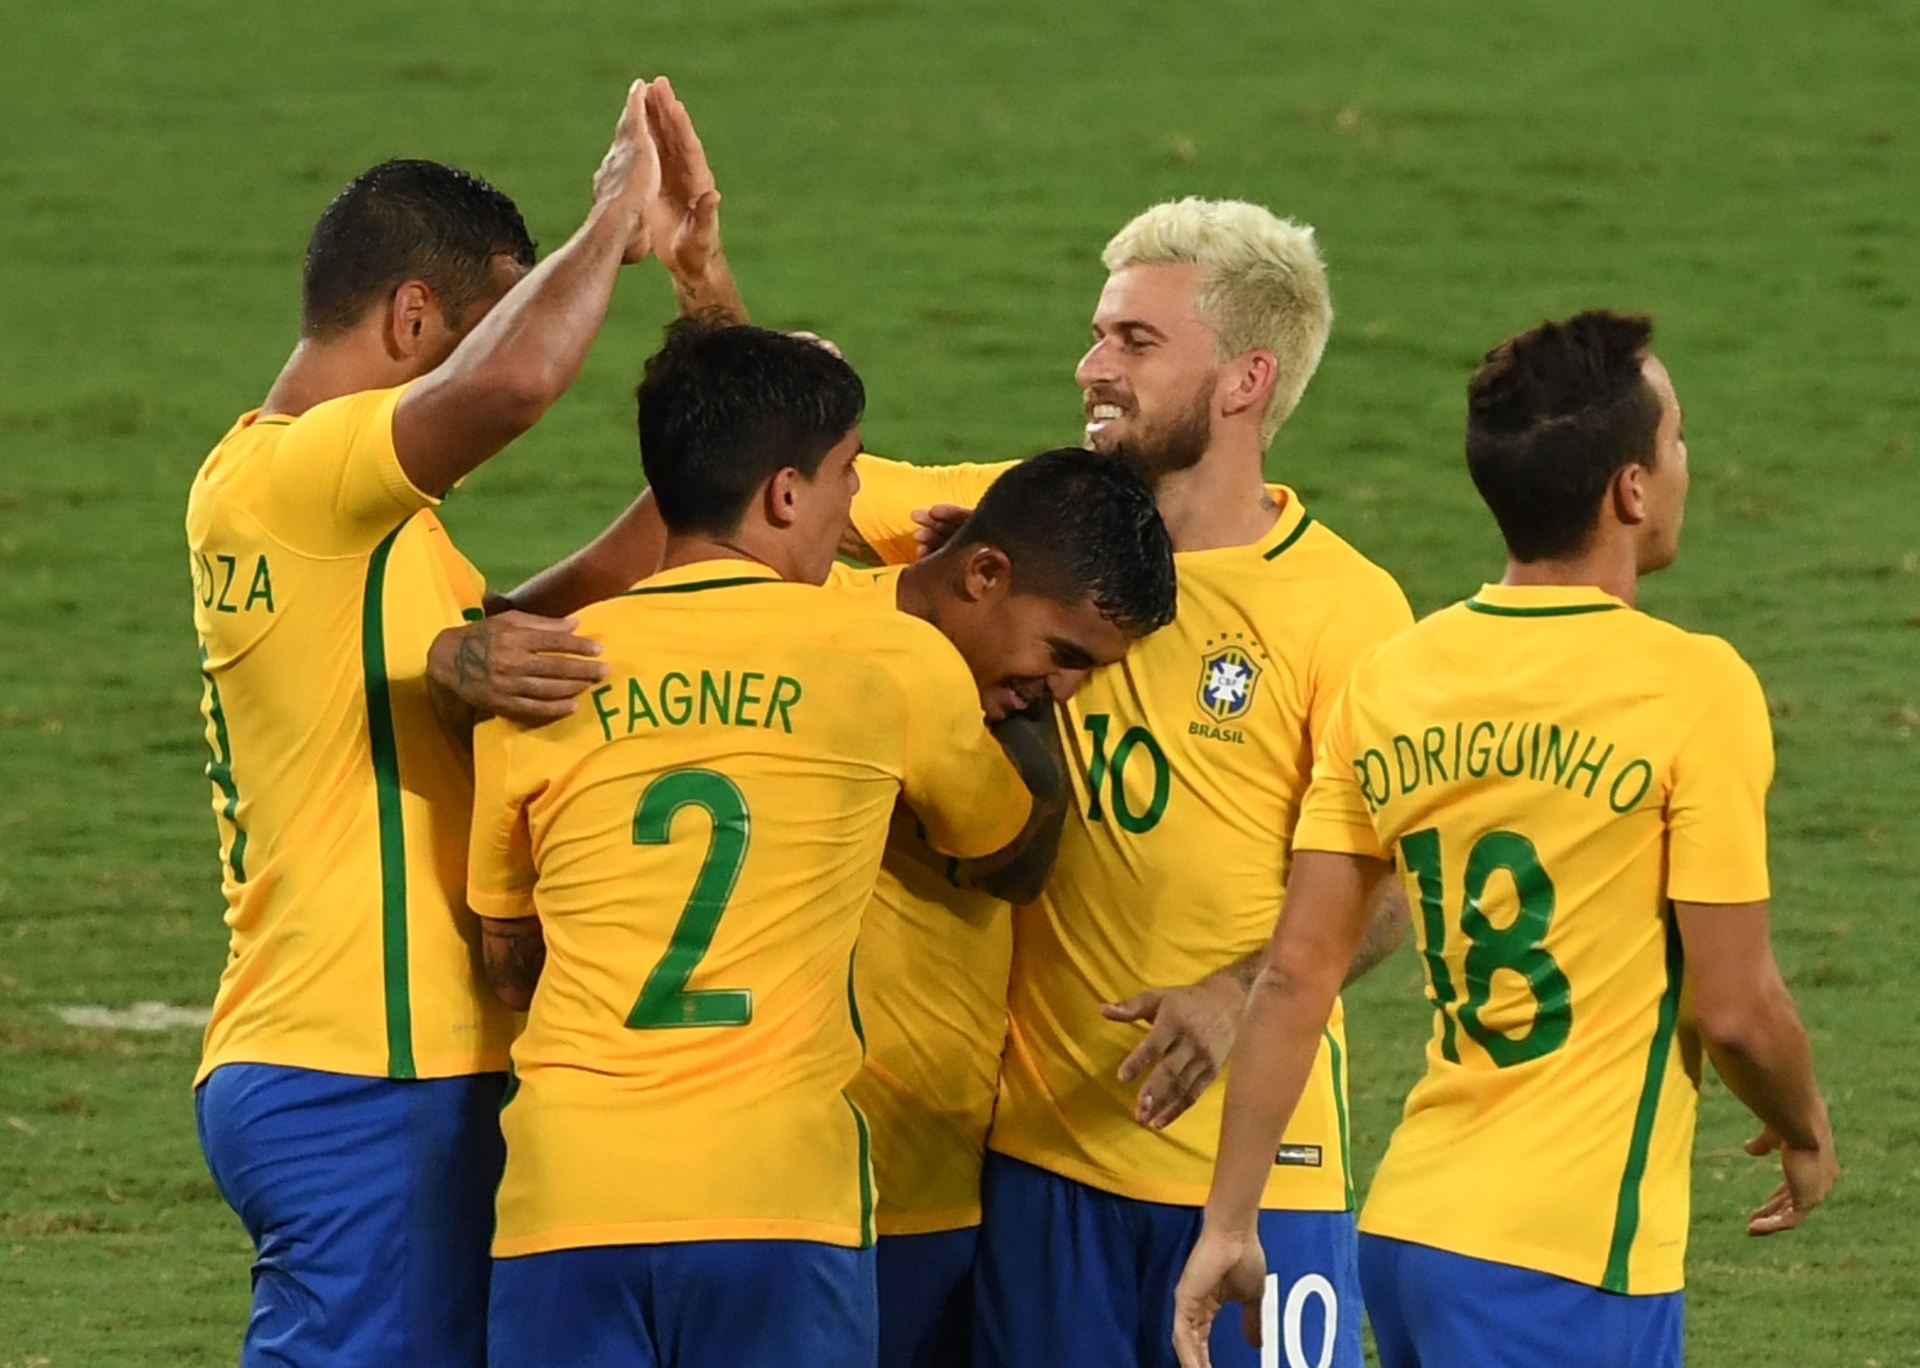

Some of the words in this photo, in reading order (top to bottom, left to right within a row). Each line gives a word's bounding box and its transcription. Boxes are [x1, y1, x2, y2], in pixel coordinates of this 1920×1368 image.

[591, 670, 802, 742] FAGNER
[1188, 721, 1245, 744] BRASIL
[1084, 713, 1171, 834] 10
[1353, 721, 1652, 814] RODRIGUINHO
[624, 766, 752, 1030] 2
[1399, 827, 1573, 1069] 18
[1261, 1273, 1338, 1368] 10
